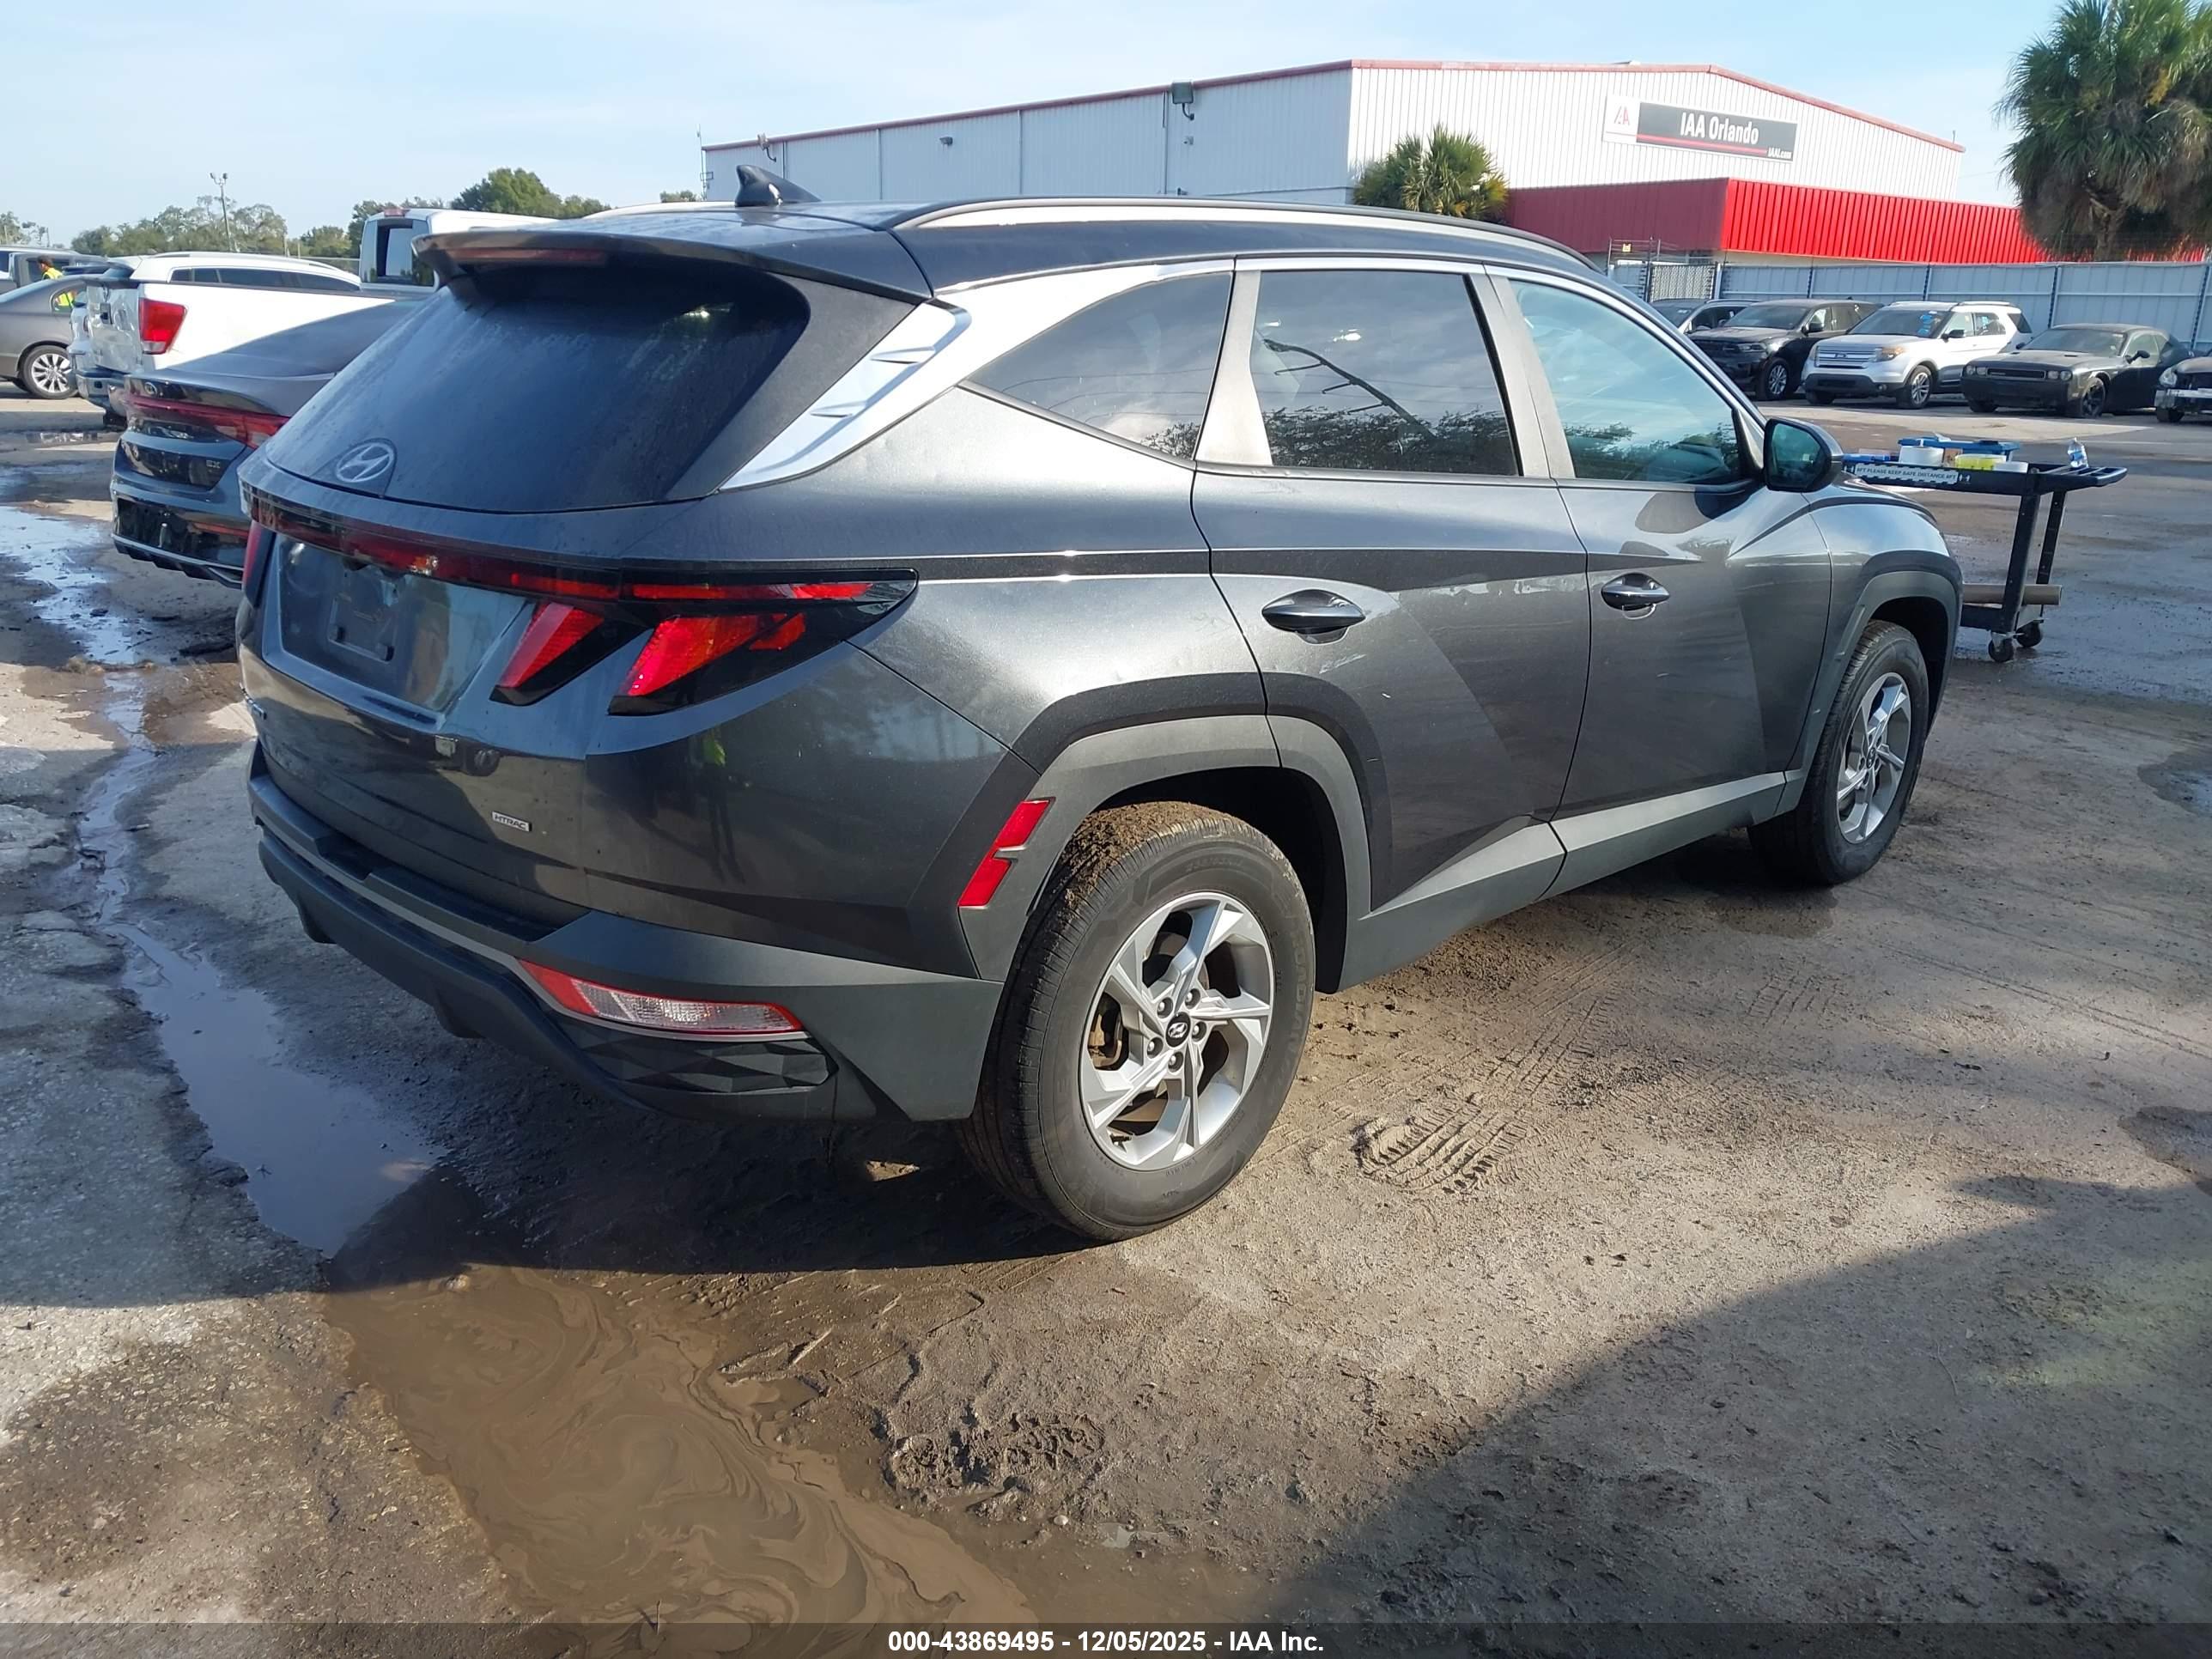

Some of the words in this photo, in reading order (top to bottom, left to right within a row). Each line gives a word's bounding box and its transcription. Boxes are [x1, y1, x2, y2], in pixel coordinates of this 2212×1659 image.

[1680, 112, 1705, 138] IAA
[1709, 116, 1759, 145] Orlando
[1917, 471, 1945, 479] DISTANCE
[494, 813, 527, 830] HTRAC
